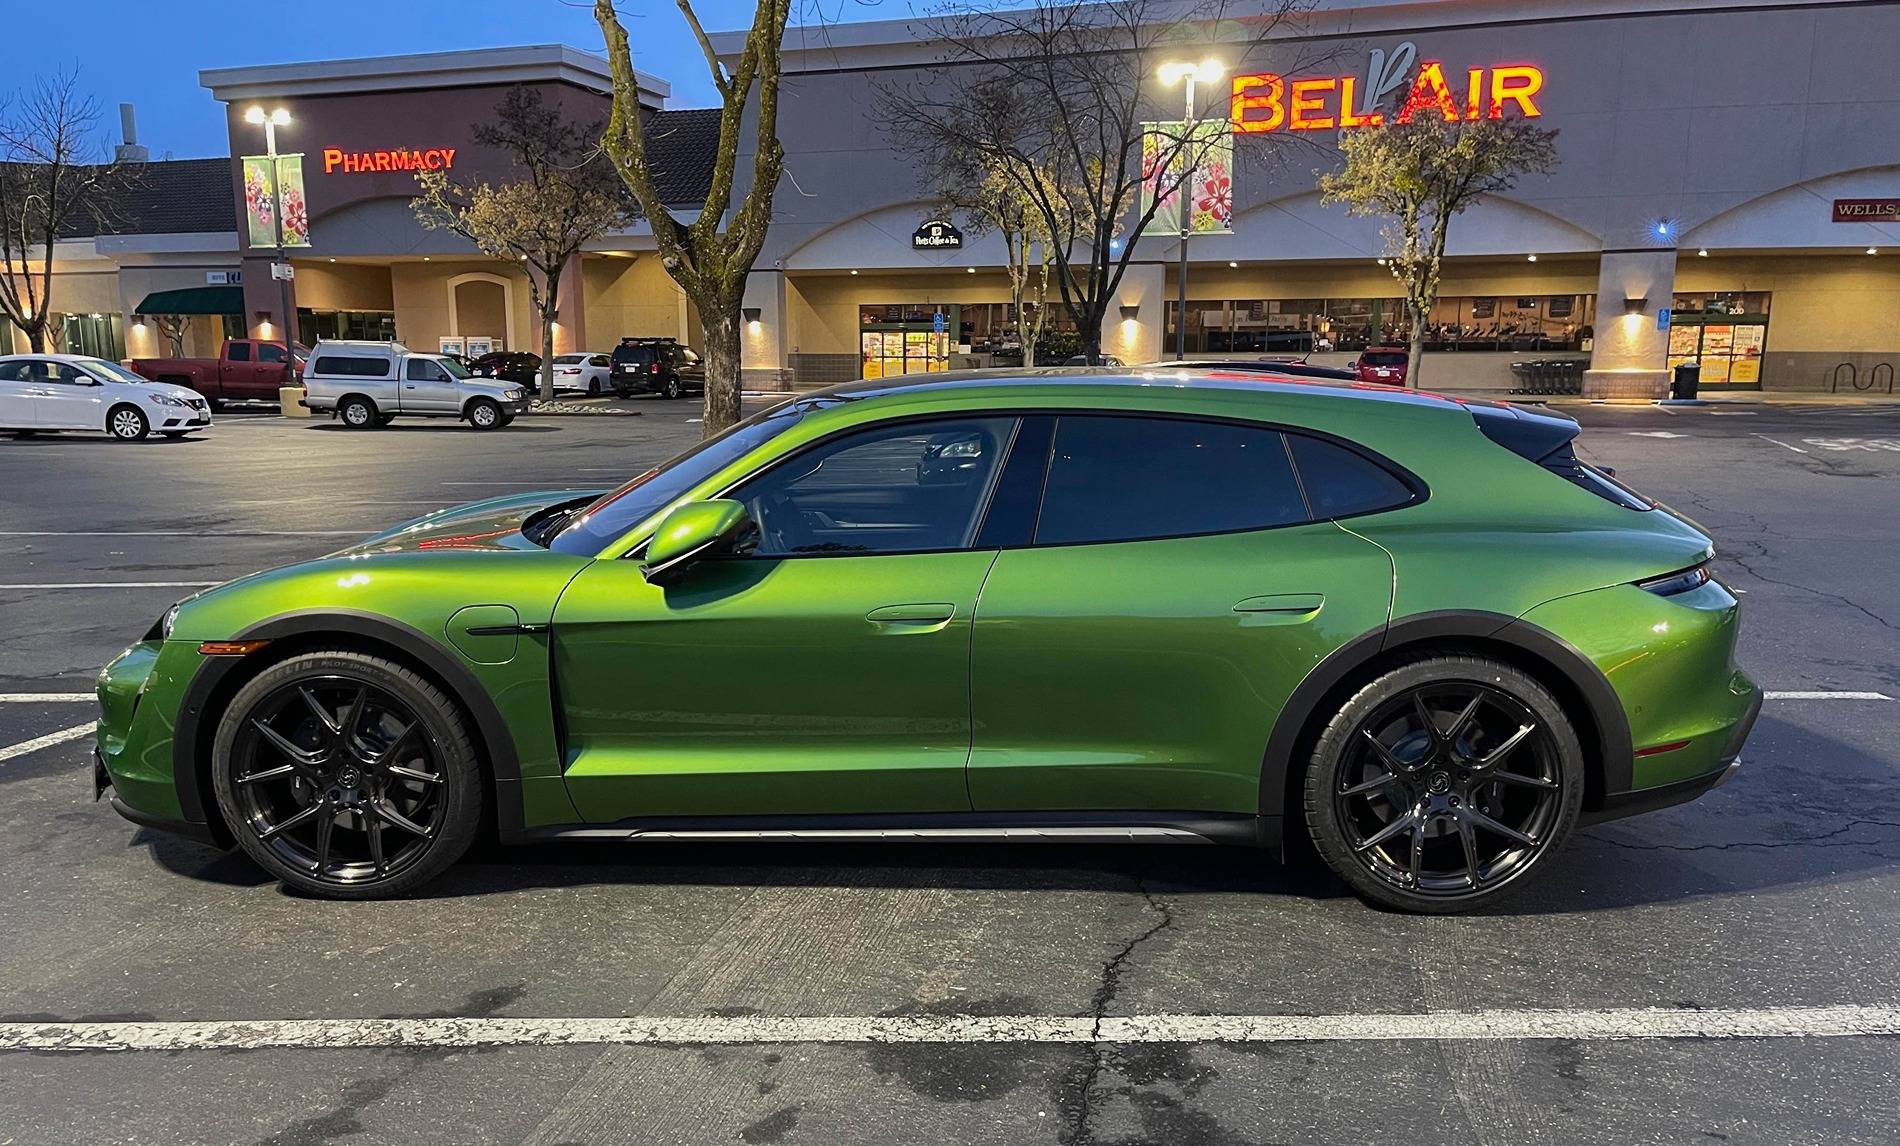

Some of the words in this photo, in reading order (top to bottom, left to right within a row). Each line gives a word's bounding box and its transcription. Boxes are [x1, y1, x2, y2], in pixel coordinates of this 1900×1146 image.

[1231, 73, 1384, 133] BEL
[1396, 62, 1543, 125] AIR
[323, 148, 456, 173] PHARMACY
[1838, 204, 1896, 215] WELLS
[949, 235, 959, 244] Tea
